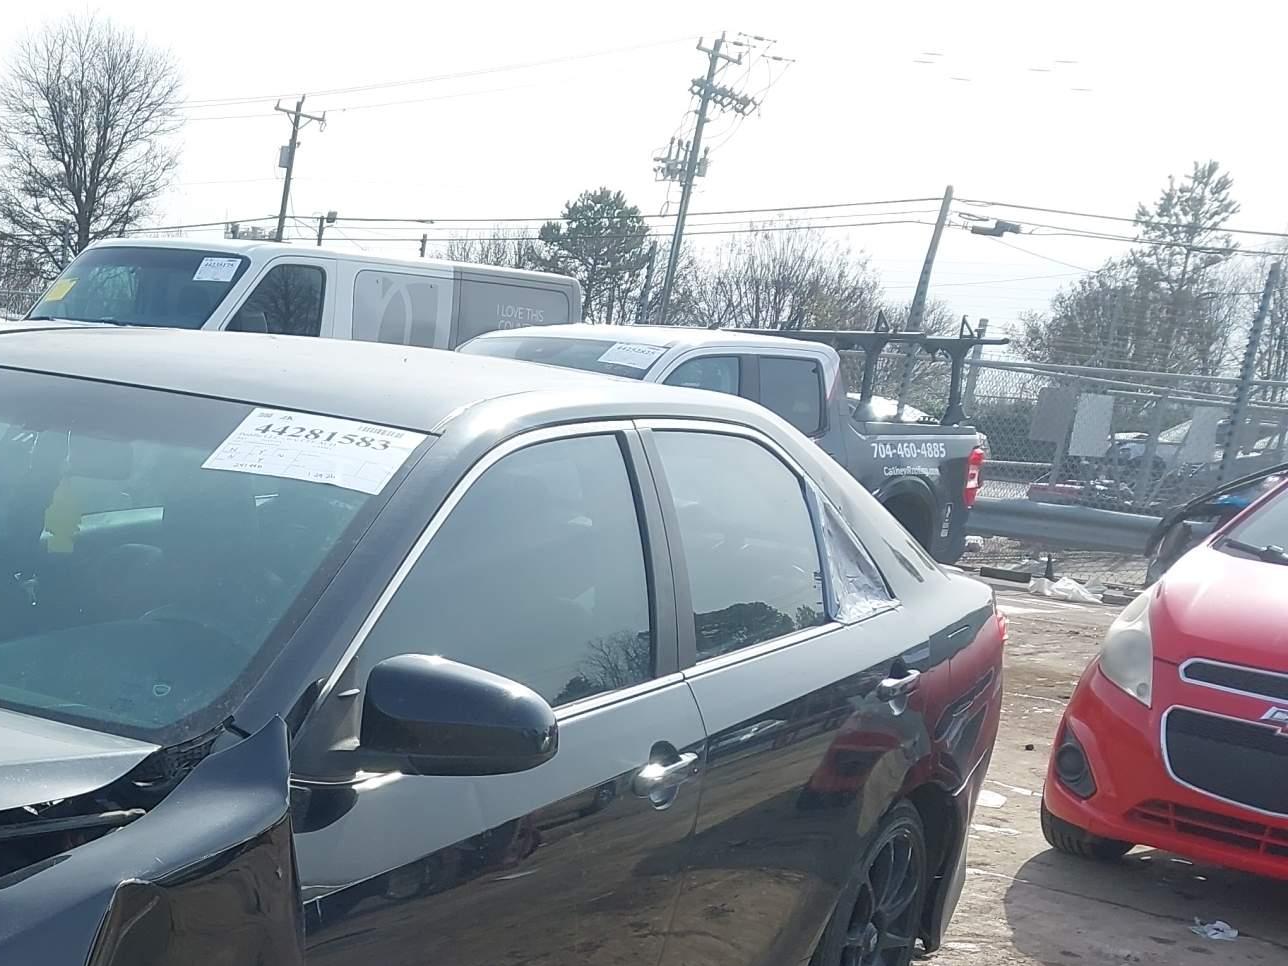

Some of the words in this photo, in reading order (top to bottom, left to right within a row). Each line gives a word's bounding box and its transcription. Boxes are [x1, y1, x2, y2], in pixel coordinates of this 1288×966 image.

[501, 304, 524, 320] LOVE
[526, 307, 545, 322] THIS
[254, 423, 392, 451] 44281583
[870, 442, 946, 458] 704-460-4885
